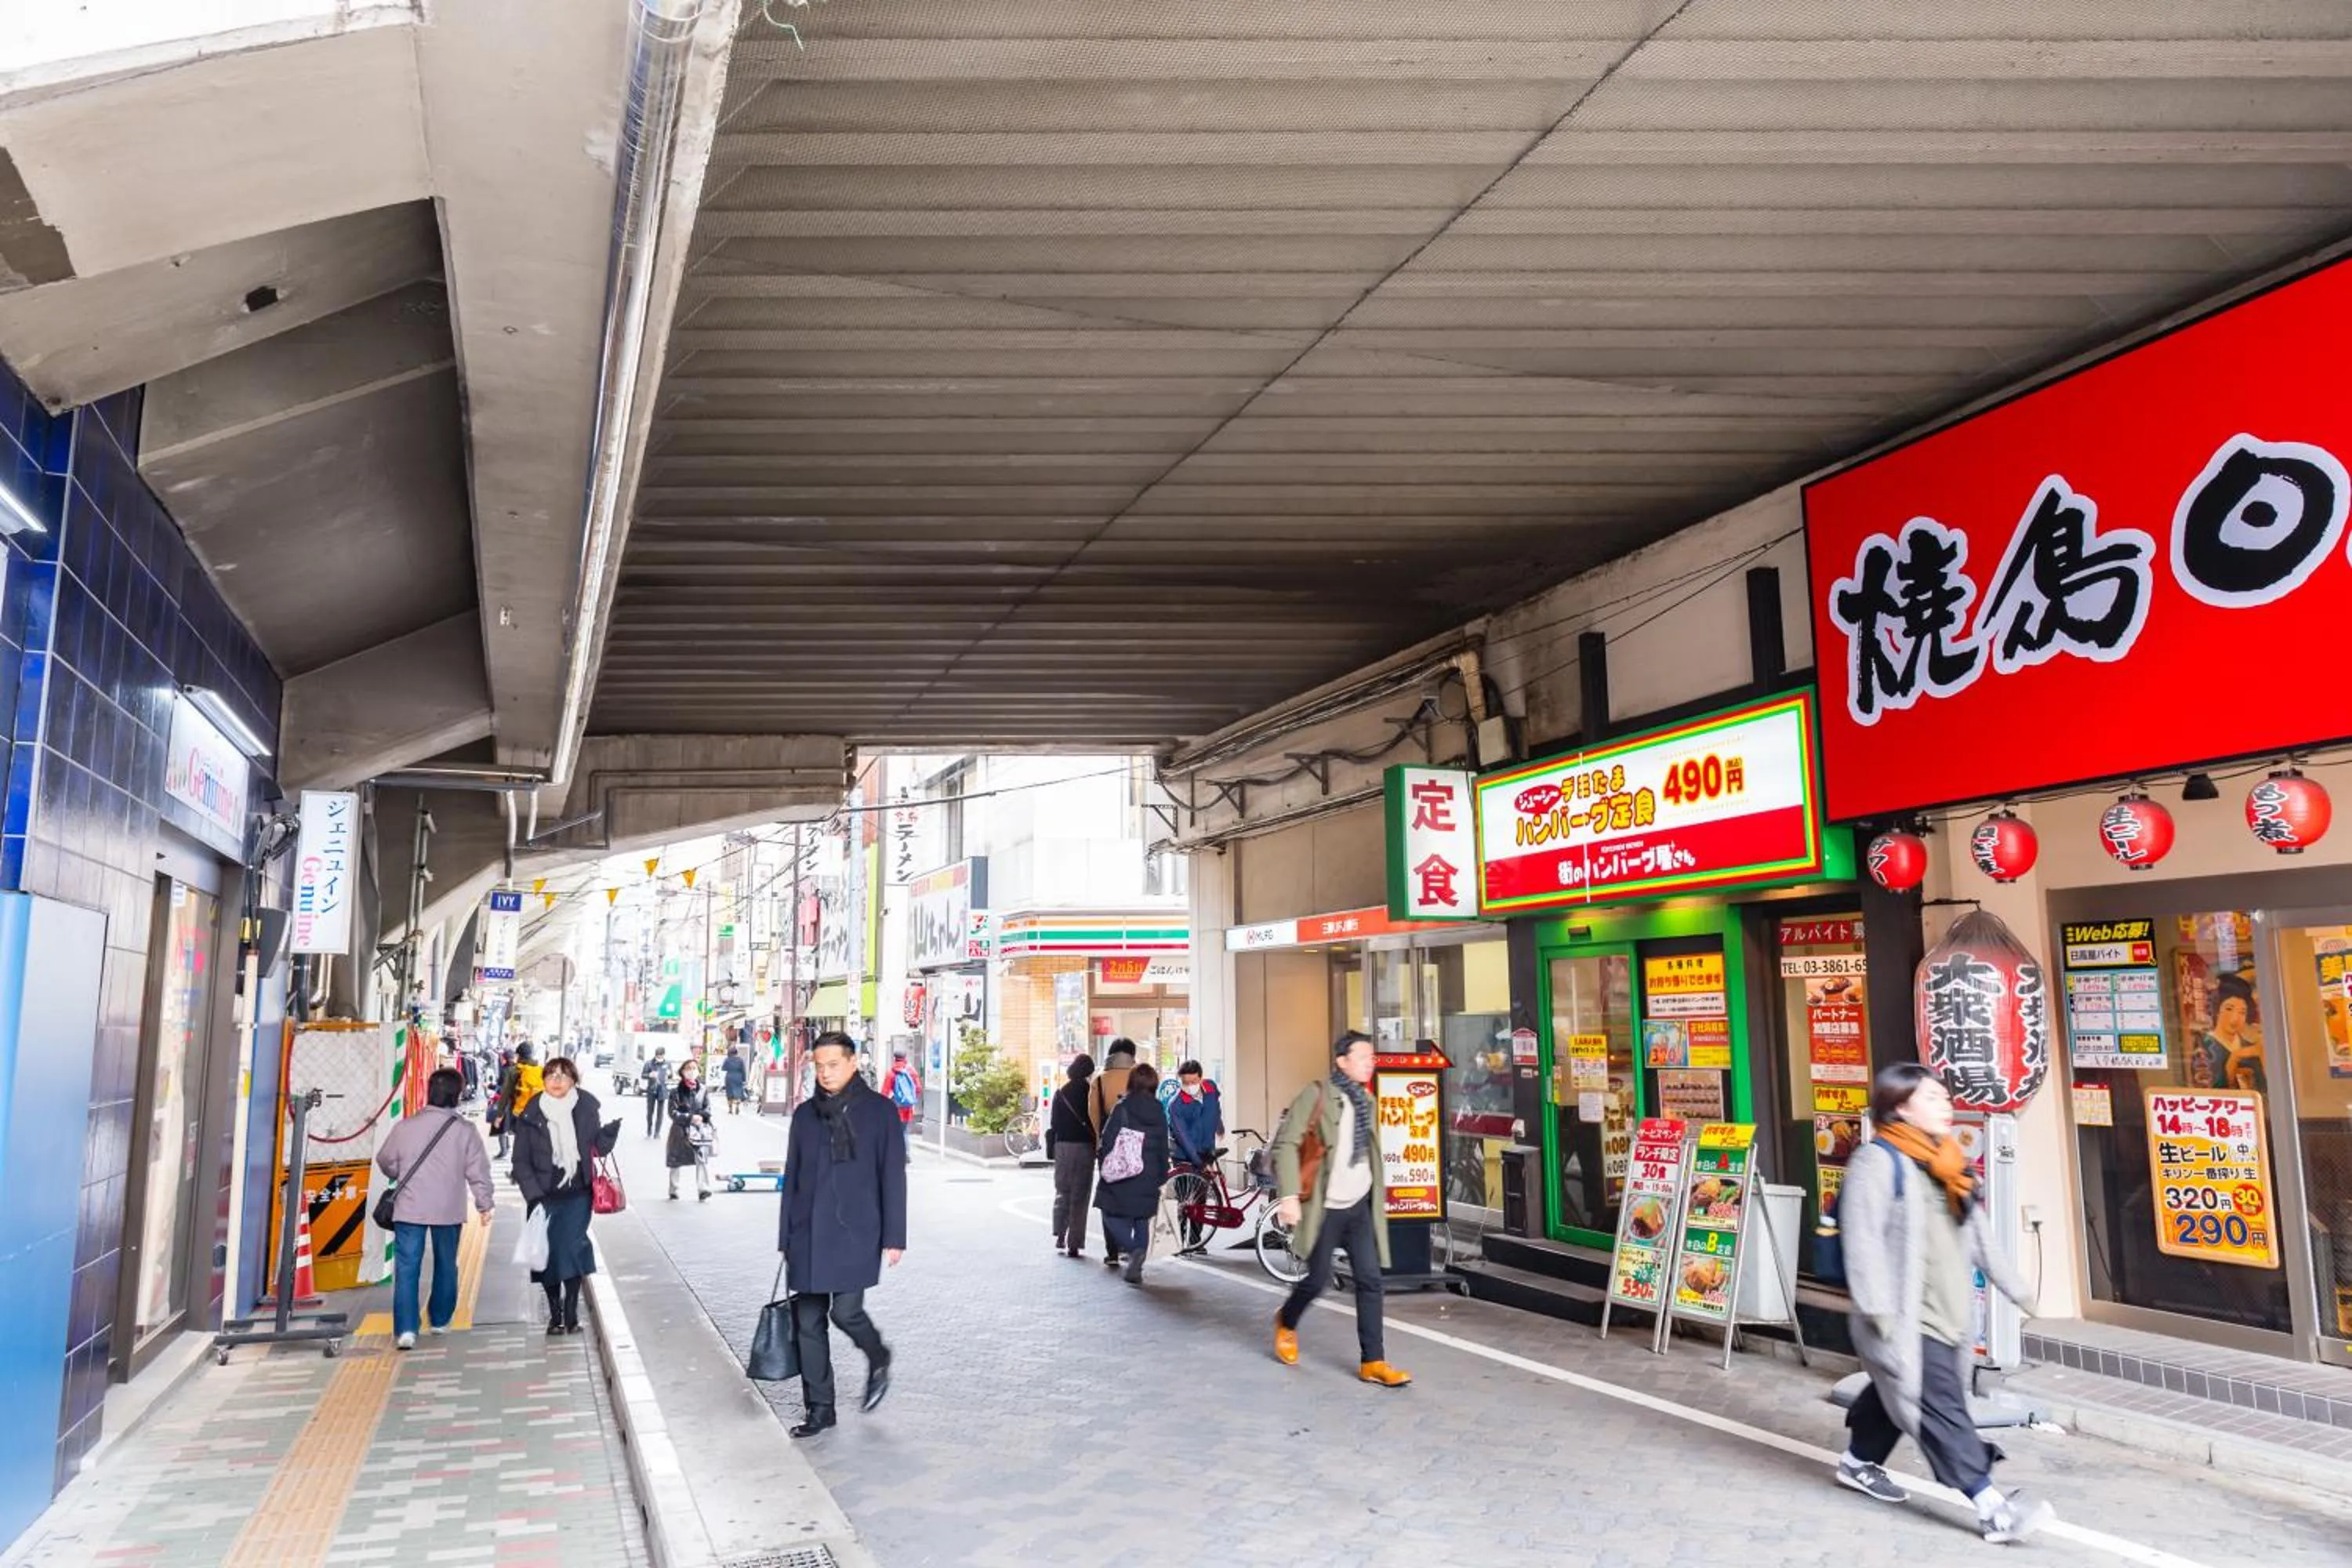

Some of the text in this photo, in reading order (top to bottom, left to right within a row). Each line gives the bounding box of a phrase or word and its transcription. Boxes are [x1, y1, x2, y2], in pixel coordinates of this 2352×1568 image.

[1519, 789, 1559, 811] ジューシー
[1562, 764, 1625, 803] デミたま
[1411, 779, 1459, 907] 定食
[1516, 787, 1656, 847] ハンバーグ定食
[321, 800, 349, 913] ジェニュイン
[296, 856, 323, 946] Genuine
[497, 895, 516, 908] IVY
[1926, 953, 2012, 1106] 大衆酒場
[2153, 1098, 2256, 1115] ハッピーアワー
